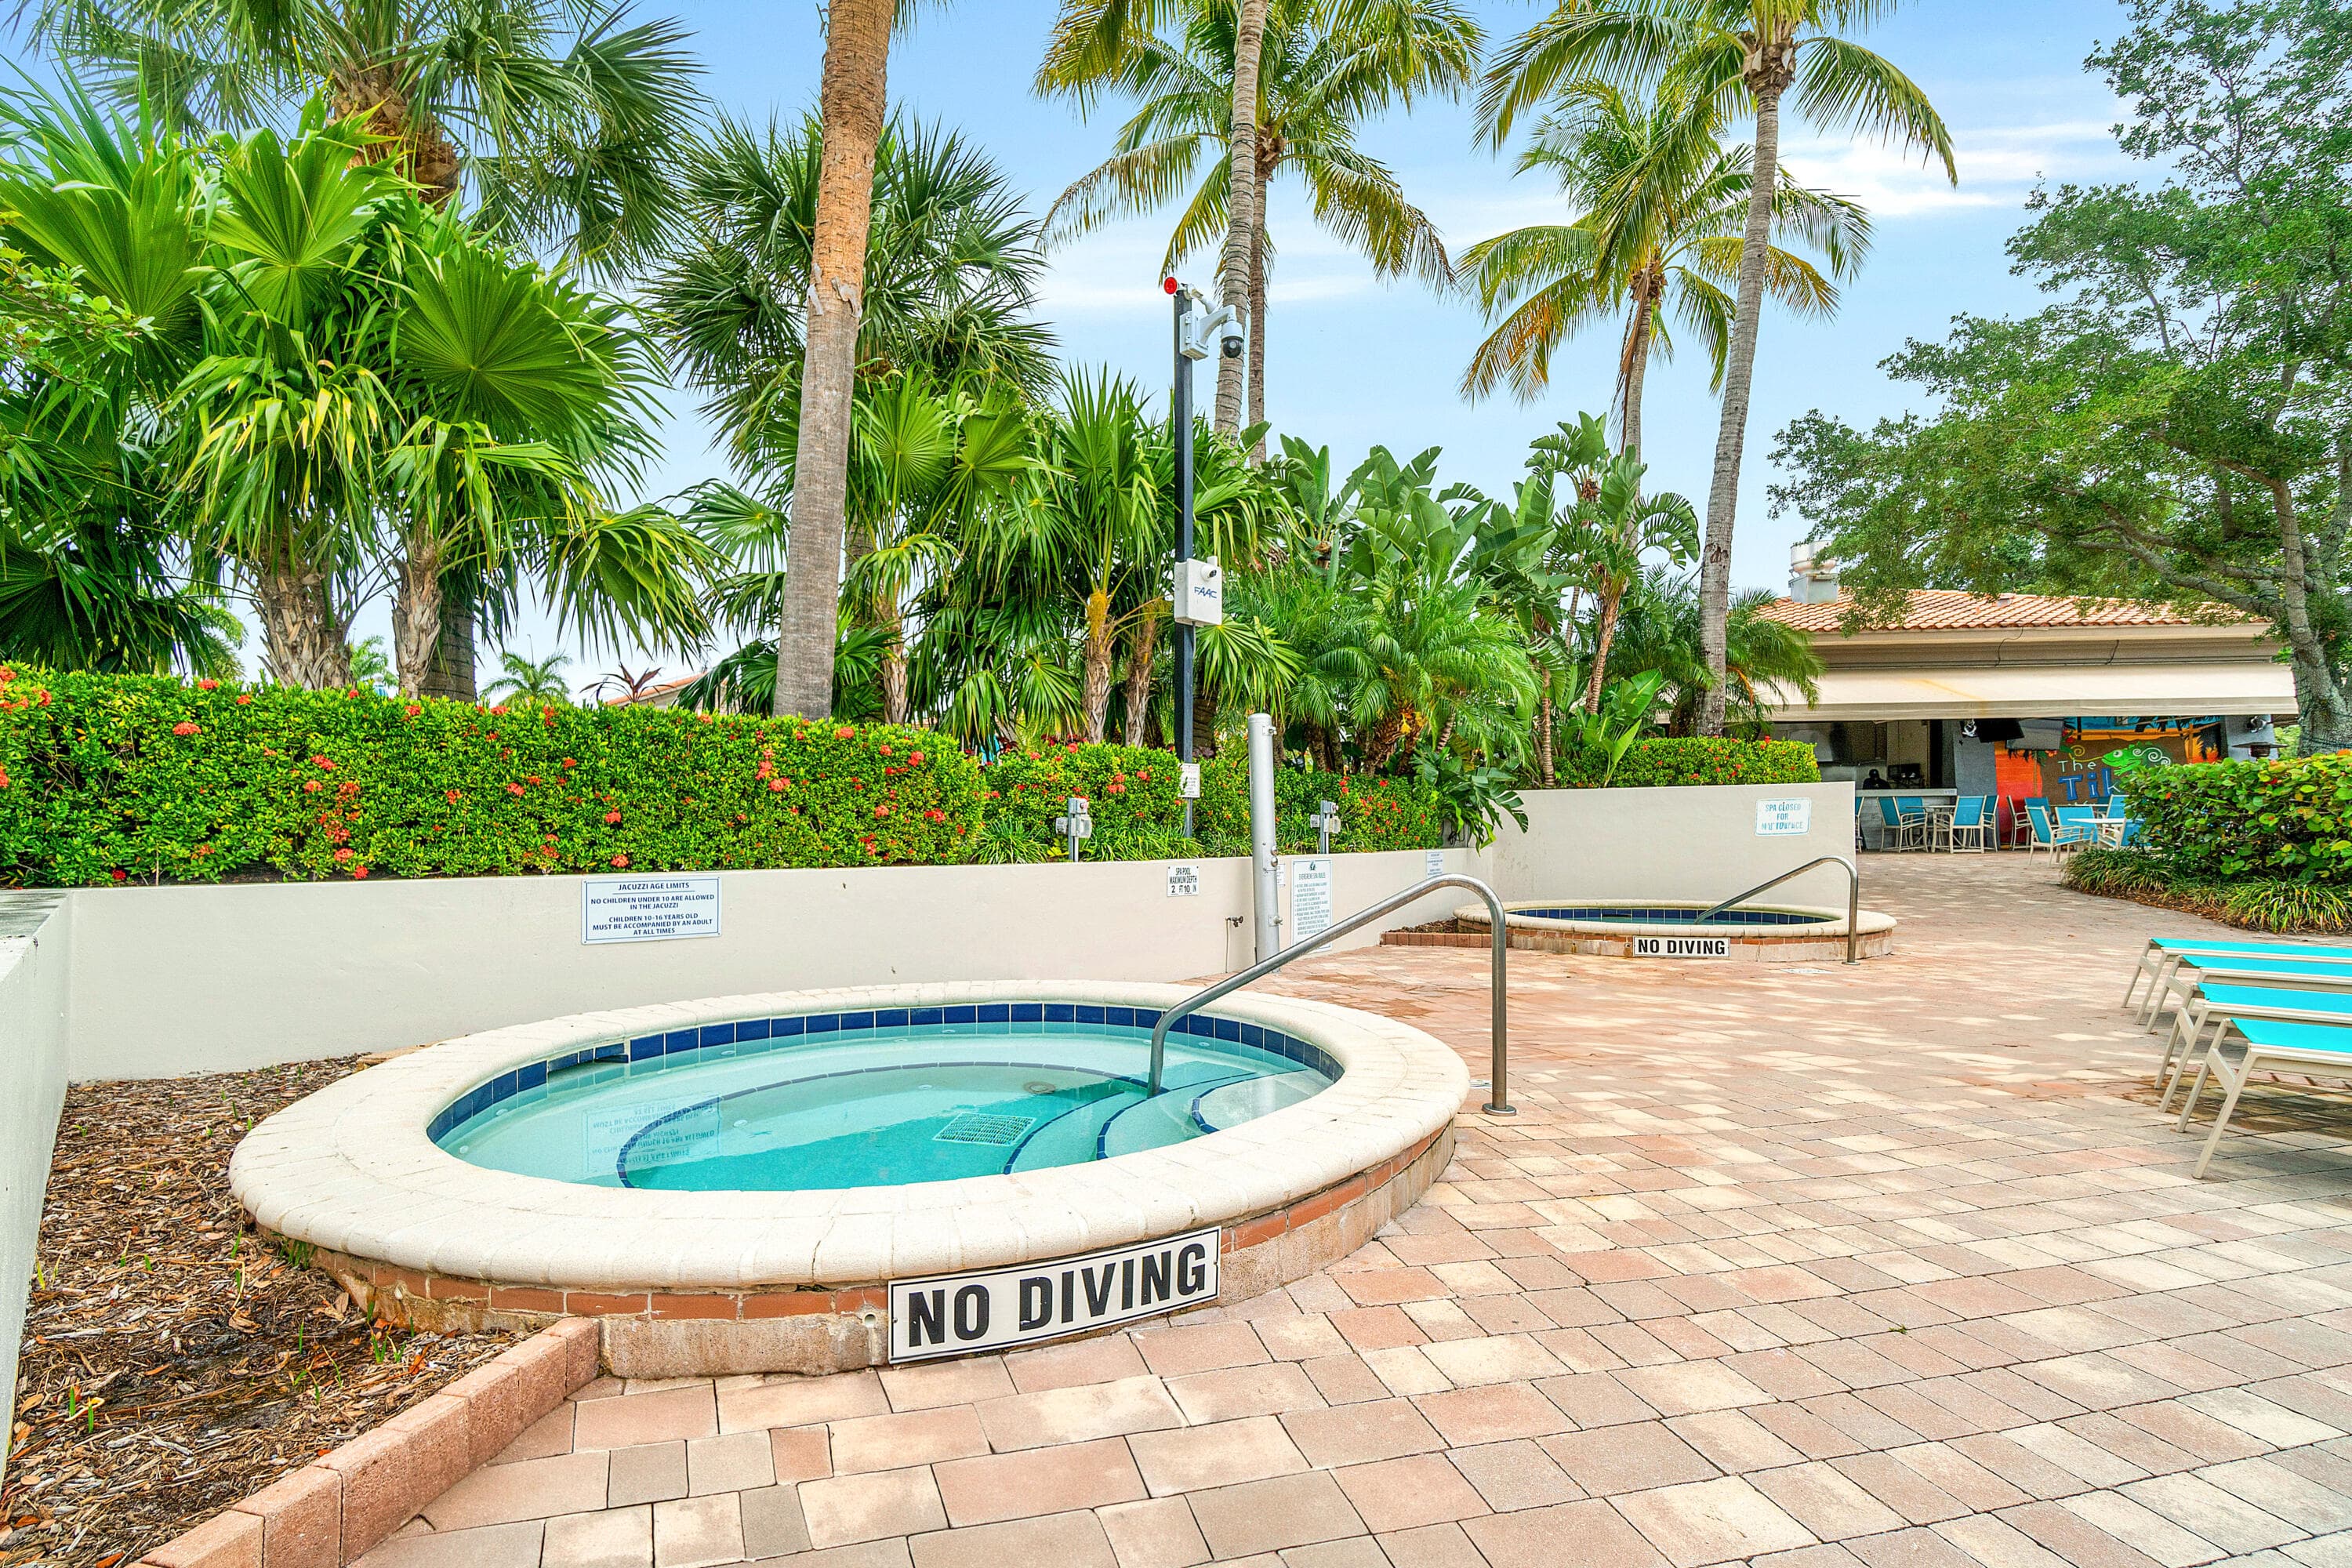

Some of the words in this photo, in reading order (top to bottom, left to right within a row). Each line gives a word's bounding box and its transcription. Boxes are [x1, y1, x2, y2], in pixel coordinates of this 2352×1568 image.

[1194, 586, 1217, 598] FAAC
[2057, 757, 2096, 772] The
[2058, 768, 2122, 801] Tik
[1766, 804, 1777, 812] SPA
[1778, 803, 1802, 811] CLOSED
[1639, 939, 1659, 953] NO
[1667, 940, 1725, 955] DIVING
[908, 1284, 989, 1348] NO
[1019, 1243, 1206, 1332] DIVING
